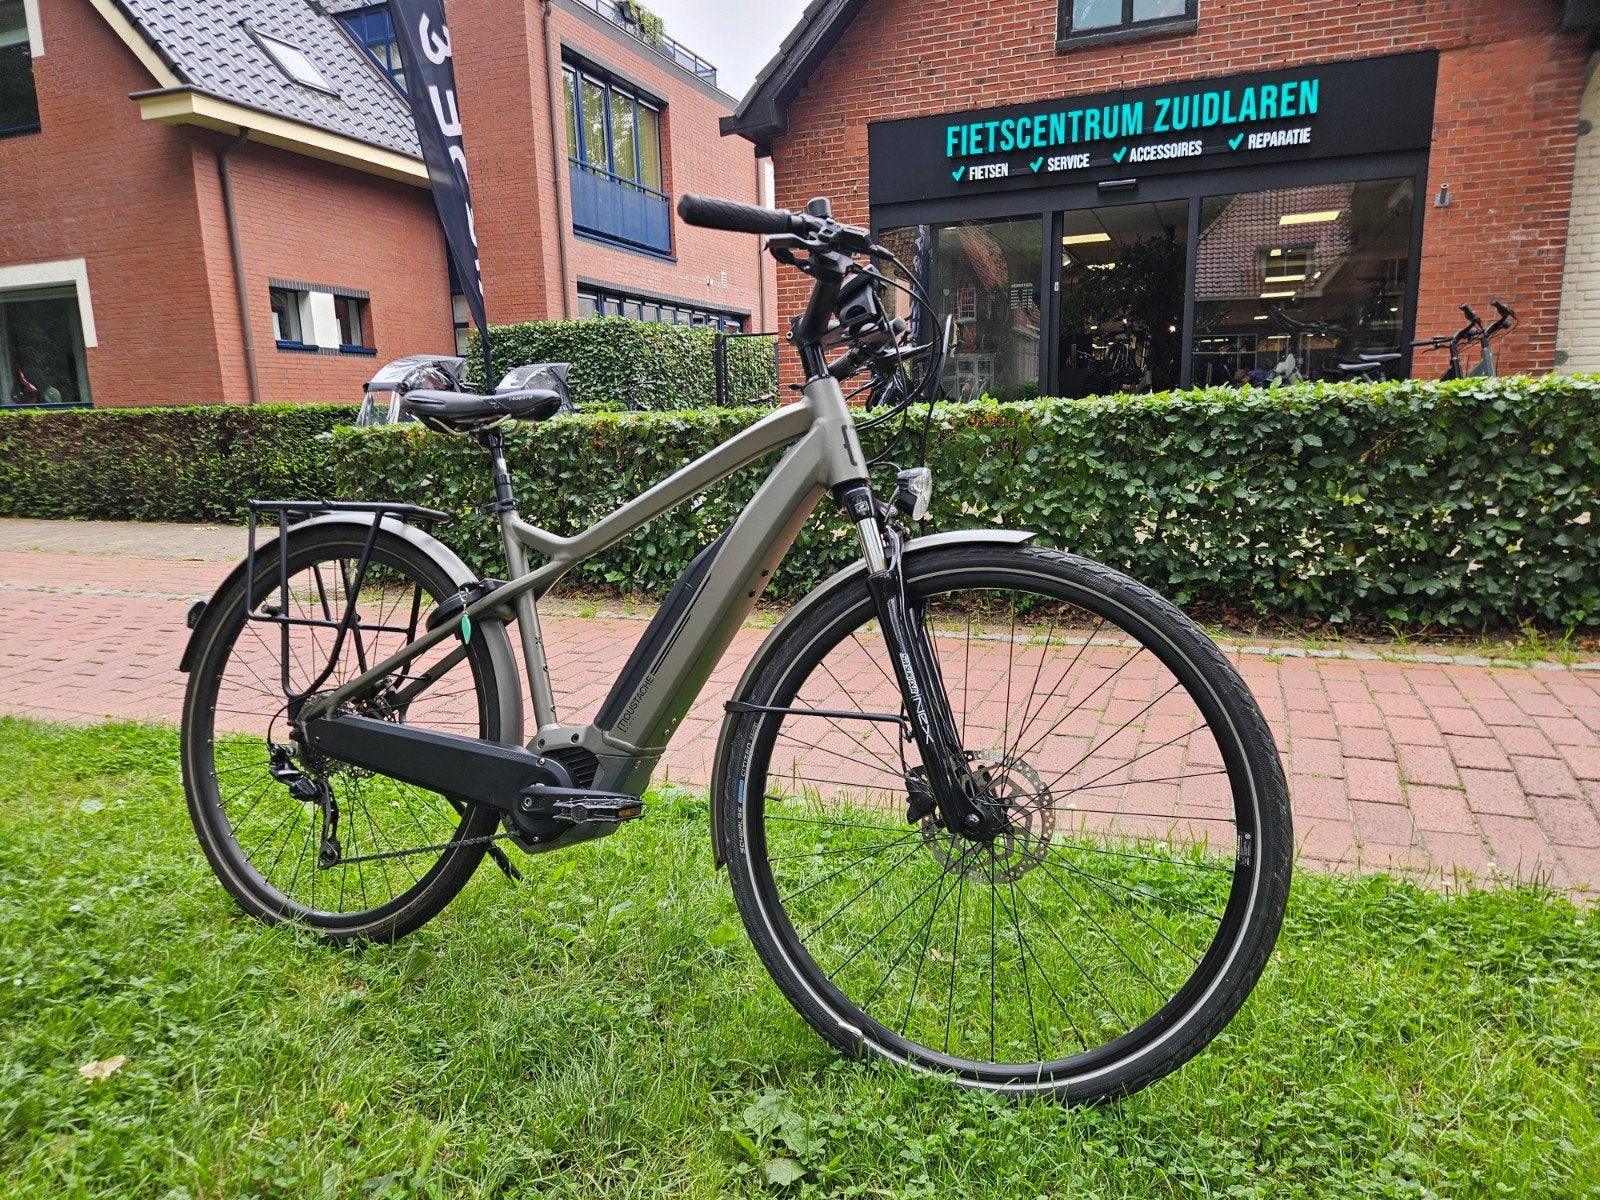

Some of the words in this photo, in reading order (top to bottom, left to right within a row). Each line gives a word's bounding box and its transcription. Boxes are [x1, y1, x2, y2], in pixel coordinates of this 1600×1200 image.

[946, 101, 1144, 157] FIETSCENTRUM
[1153, 78, 1320, 132] ZUIDLAREN
[1247, 127, 1312, 150] REPARATIE
[1047, 153, 1090, 172] SERVICE
[1129, 140, 1203, 163] ACCESSOIRES
[969, 163, 1009, 181] FIETSEN
[617, 675, 654, 732] MOUSTACHE
